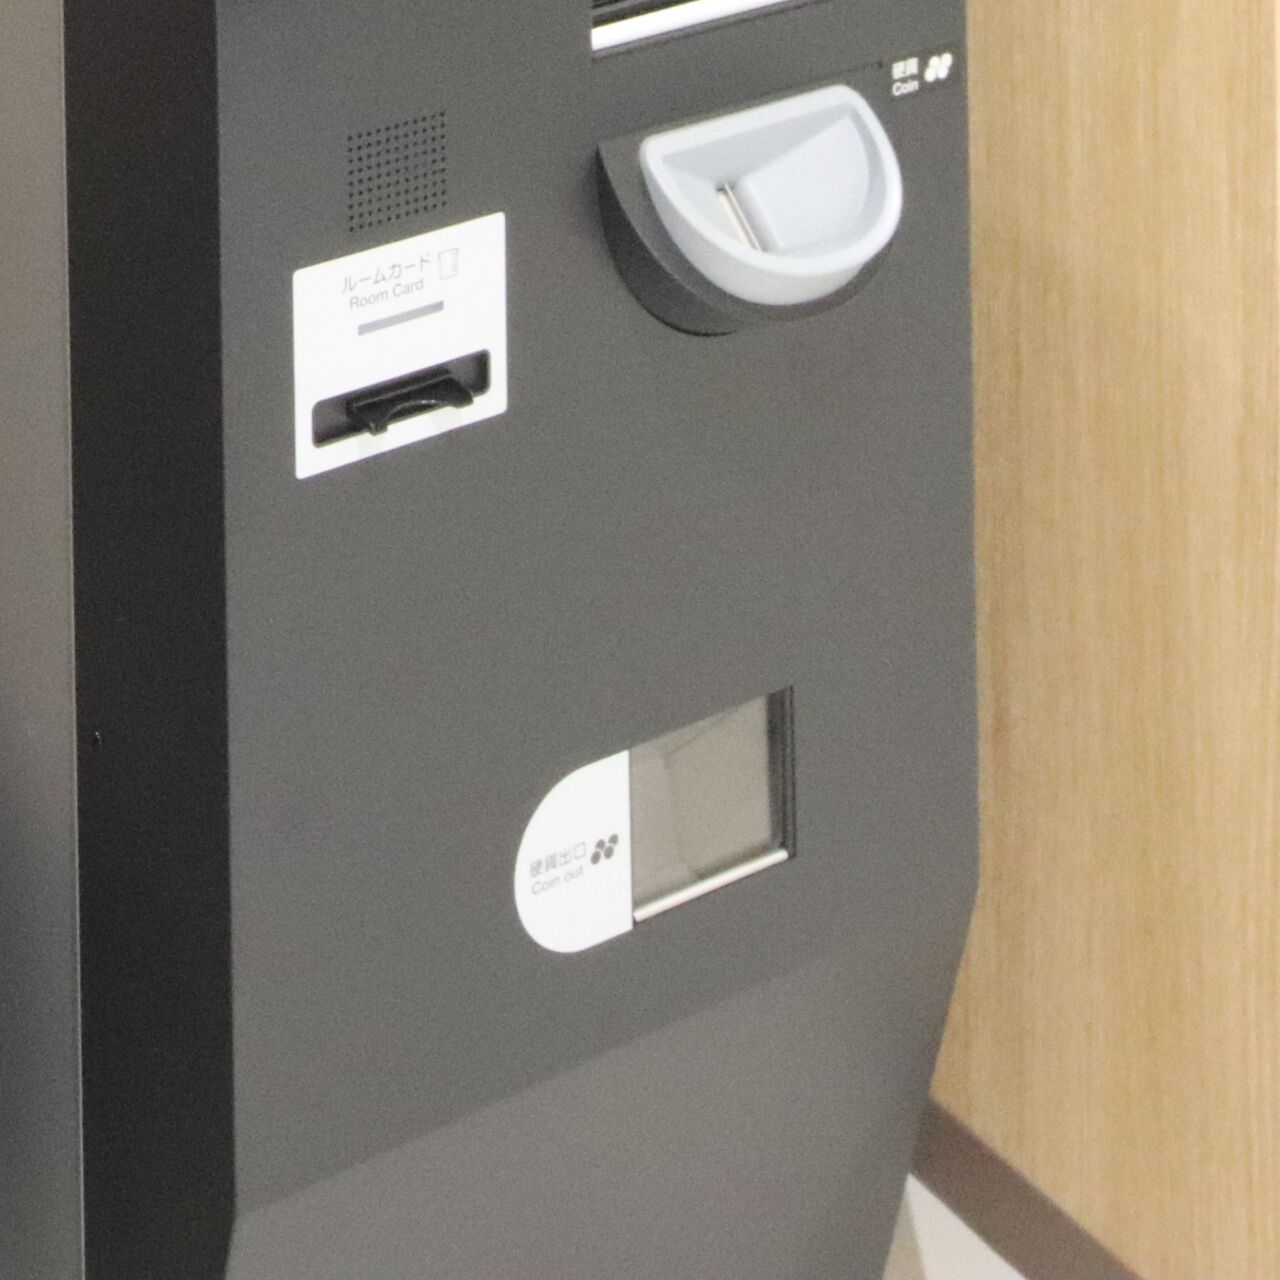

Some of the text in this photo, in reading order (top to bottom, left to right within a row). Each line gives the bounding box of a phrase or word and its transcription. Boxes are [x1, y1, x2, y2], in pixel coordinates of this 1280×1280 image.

[341, 254, 432, 294] ルームカード
[349, 277, 425, 310] Room Card
